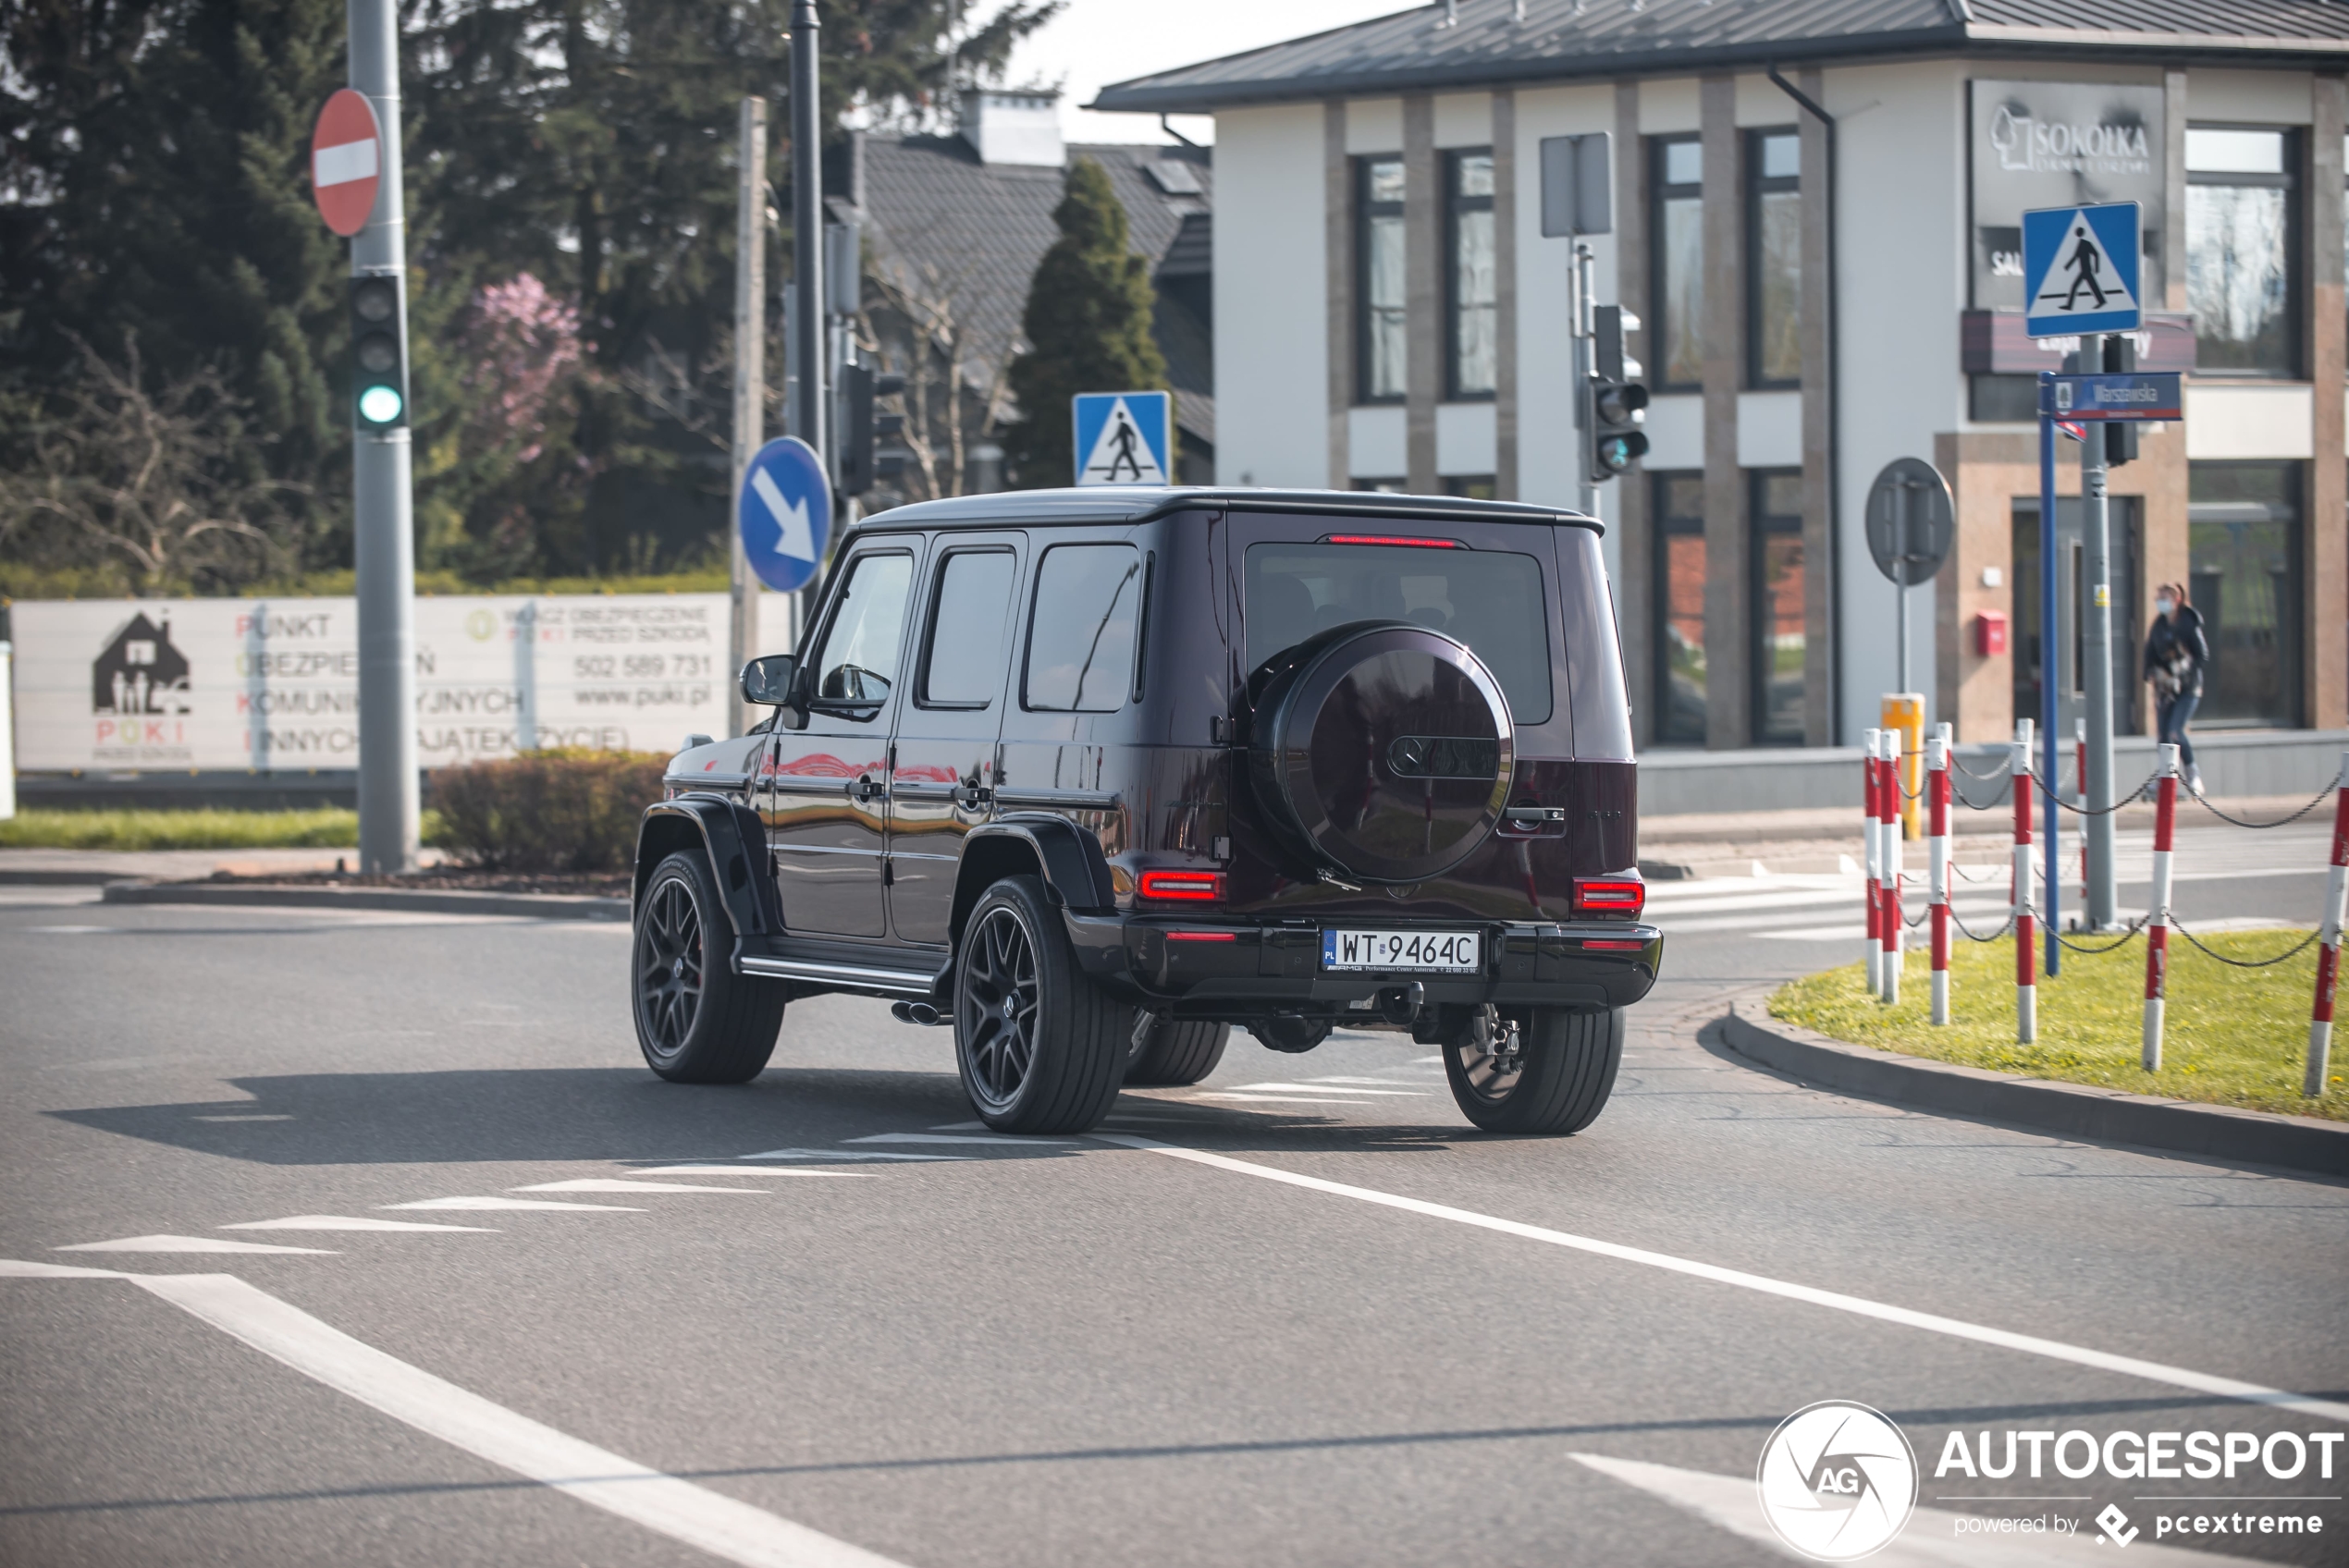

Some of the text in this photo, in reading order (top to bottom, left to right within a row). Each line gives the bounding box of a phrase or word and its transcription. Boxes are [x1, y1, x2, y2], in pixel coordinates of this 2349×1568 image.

[1992, 251, 2024, 276] SAL
[2093, 383, 2158, 402] Warszawska
[235, 614, 332, 639] PUNKT
[672, 654, 710, 676] 731
[1325, 951, 1334, 960] PL
[1343, 934, 1471, 964] WT 9464C
